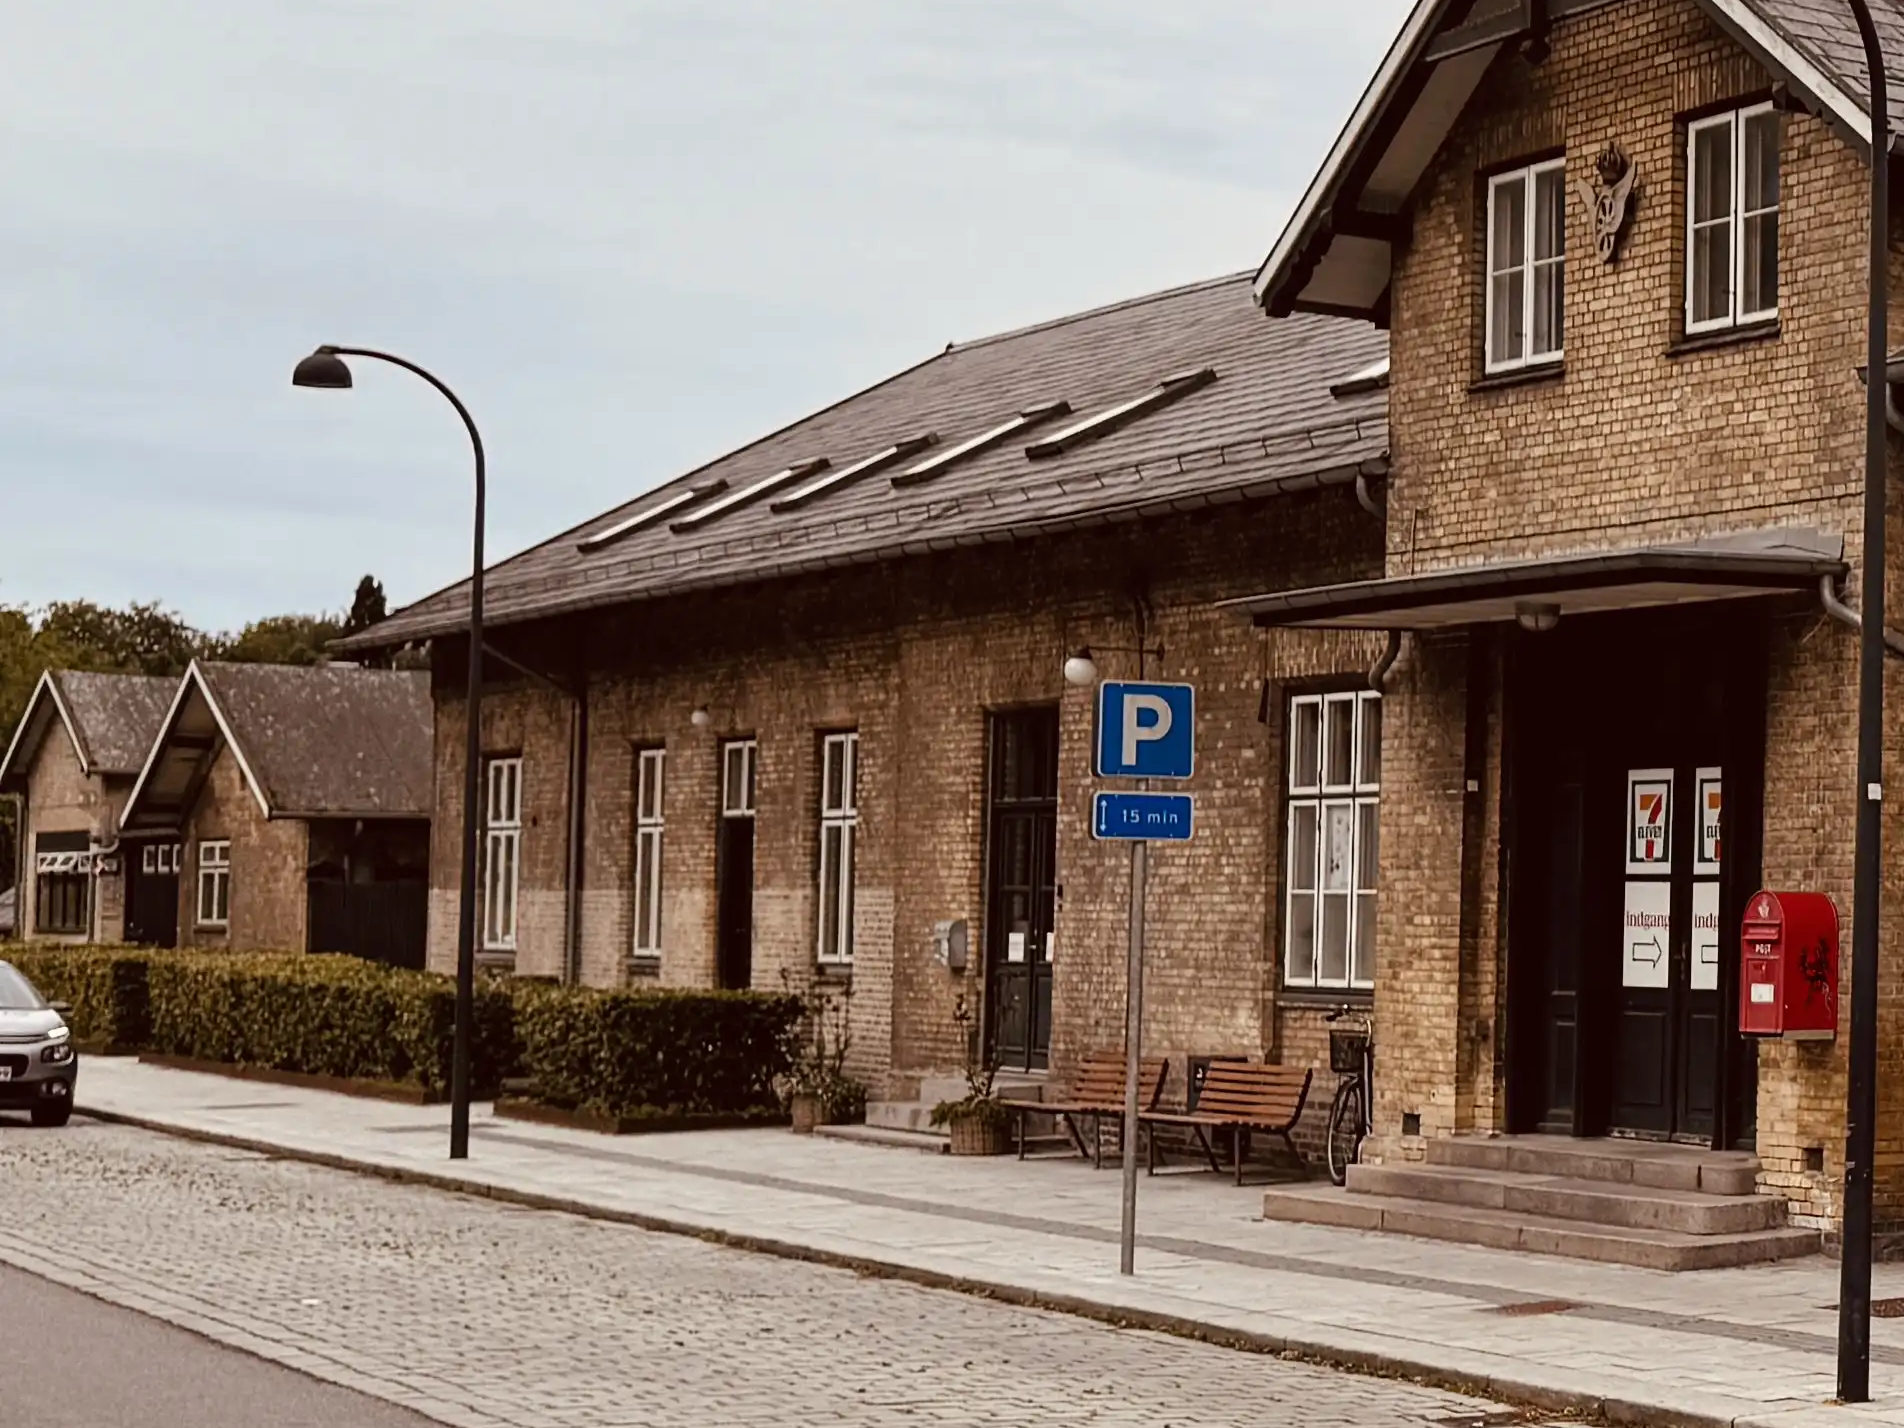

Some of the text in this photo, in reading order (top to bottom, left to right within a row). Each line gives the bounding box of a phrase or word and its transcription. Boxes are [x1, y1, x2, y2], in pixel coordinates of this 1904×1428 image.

[1122, 694, 1172, 766] P
[1122, 809, 1178, 825] 15 min
[1755, 943, 1771, 955] POST
